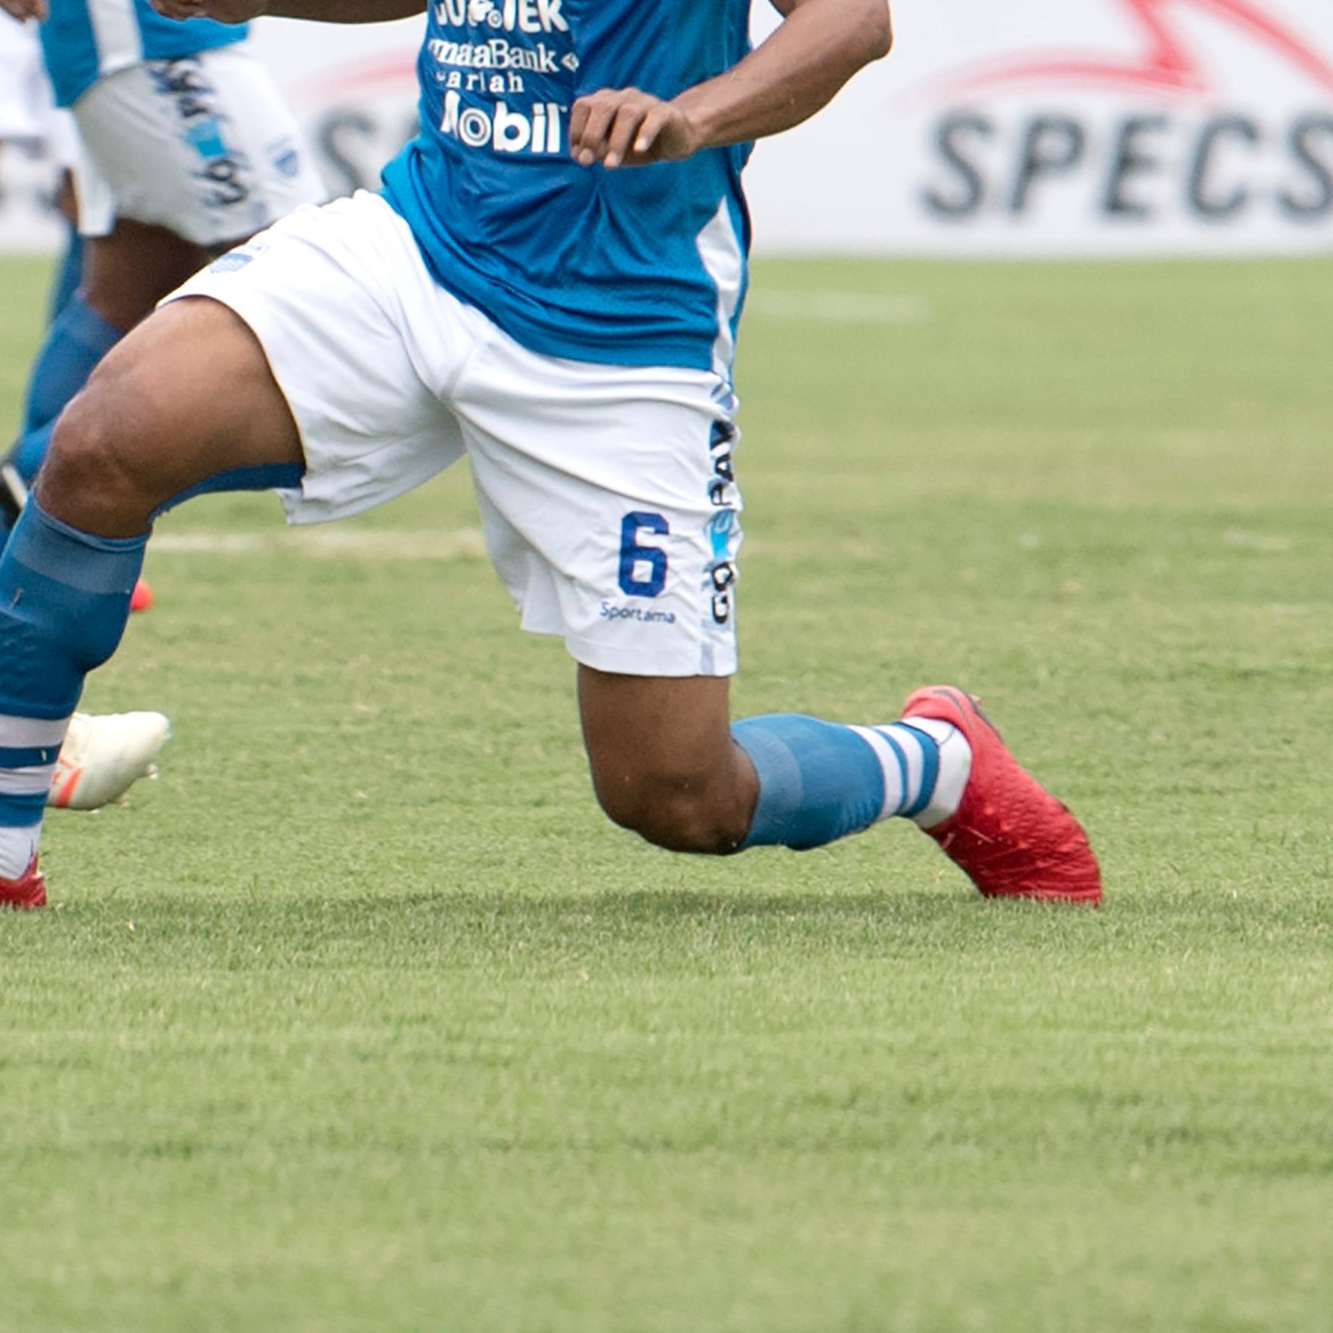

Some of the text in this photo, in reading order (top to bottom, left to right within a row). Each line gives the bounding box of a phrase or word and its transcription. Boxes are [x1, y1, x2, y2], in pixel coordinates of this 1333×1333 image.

[917, 112, 1333, 225] SPECS
[618, 510, 671, 598] 6
[599, 600, 677, 625] Sportama
